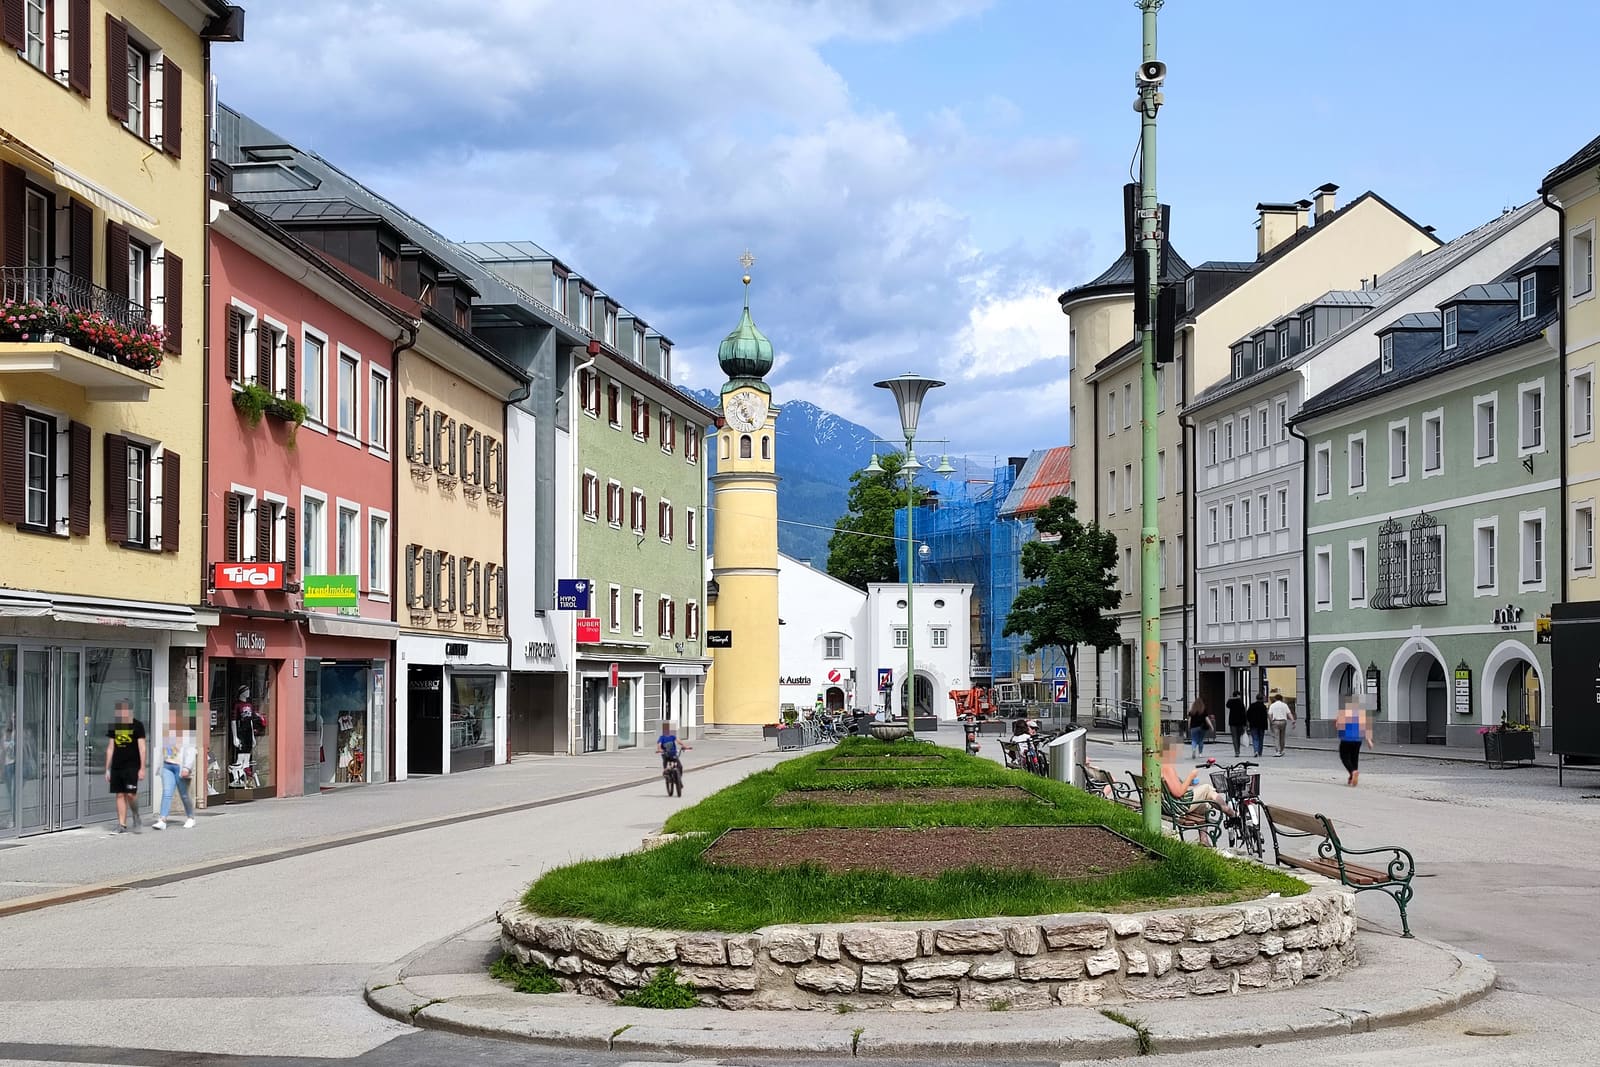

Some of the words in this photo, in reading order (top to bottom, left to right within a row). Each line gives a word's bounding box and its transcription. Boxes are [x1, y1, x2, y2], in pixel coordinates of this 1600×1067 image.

[223, 566, 276, 586] Tirol
[577, 620, 600, 628] HUBER
[236, 632, 250, 649] Tirol
[251, 633, 265, 653] Shop
[786, 675, 812, 684] Austria
